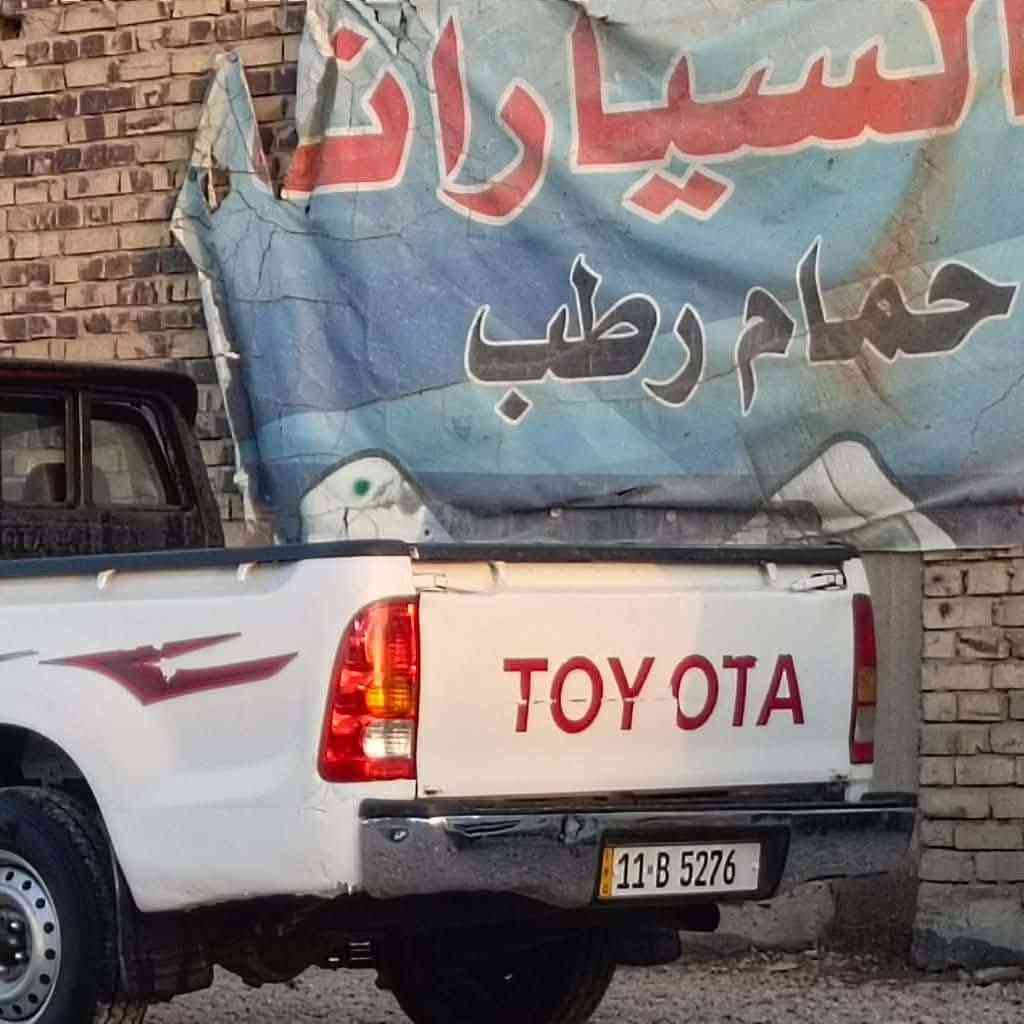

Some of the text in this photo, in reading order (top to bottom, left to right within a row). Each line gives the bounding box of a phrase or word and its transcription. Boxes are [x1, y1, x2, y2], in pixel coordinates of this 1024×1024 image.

[464, 235, 1020, 425] حمام رطب
[503, 654, 805, 734] TOYOTA
[679, 849, 736, 888] 5276
